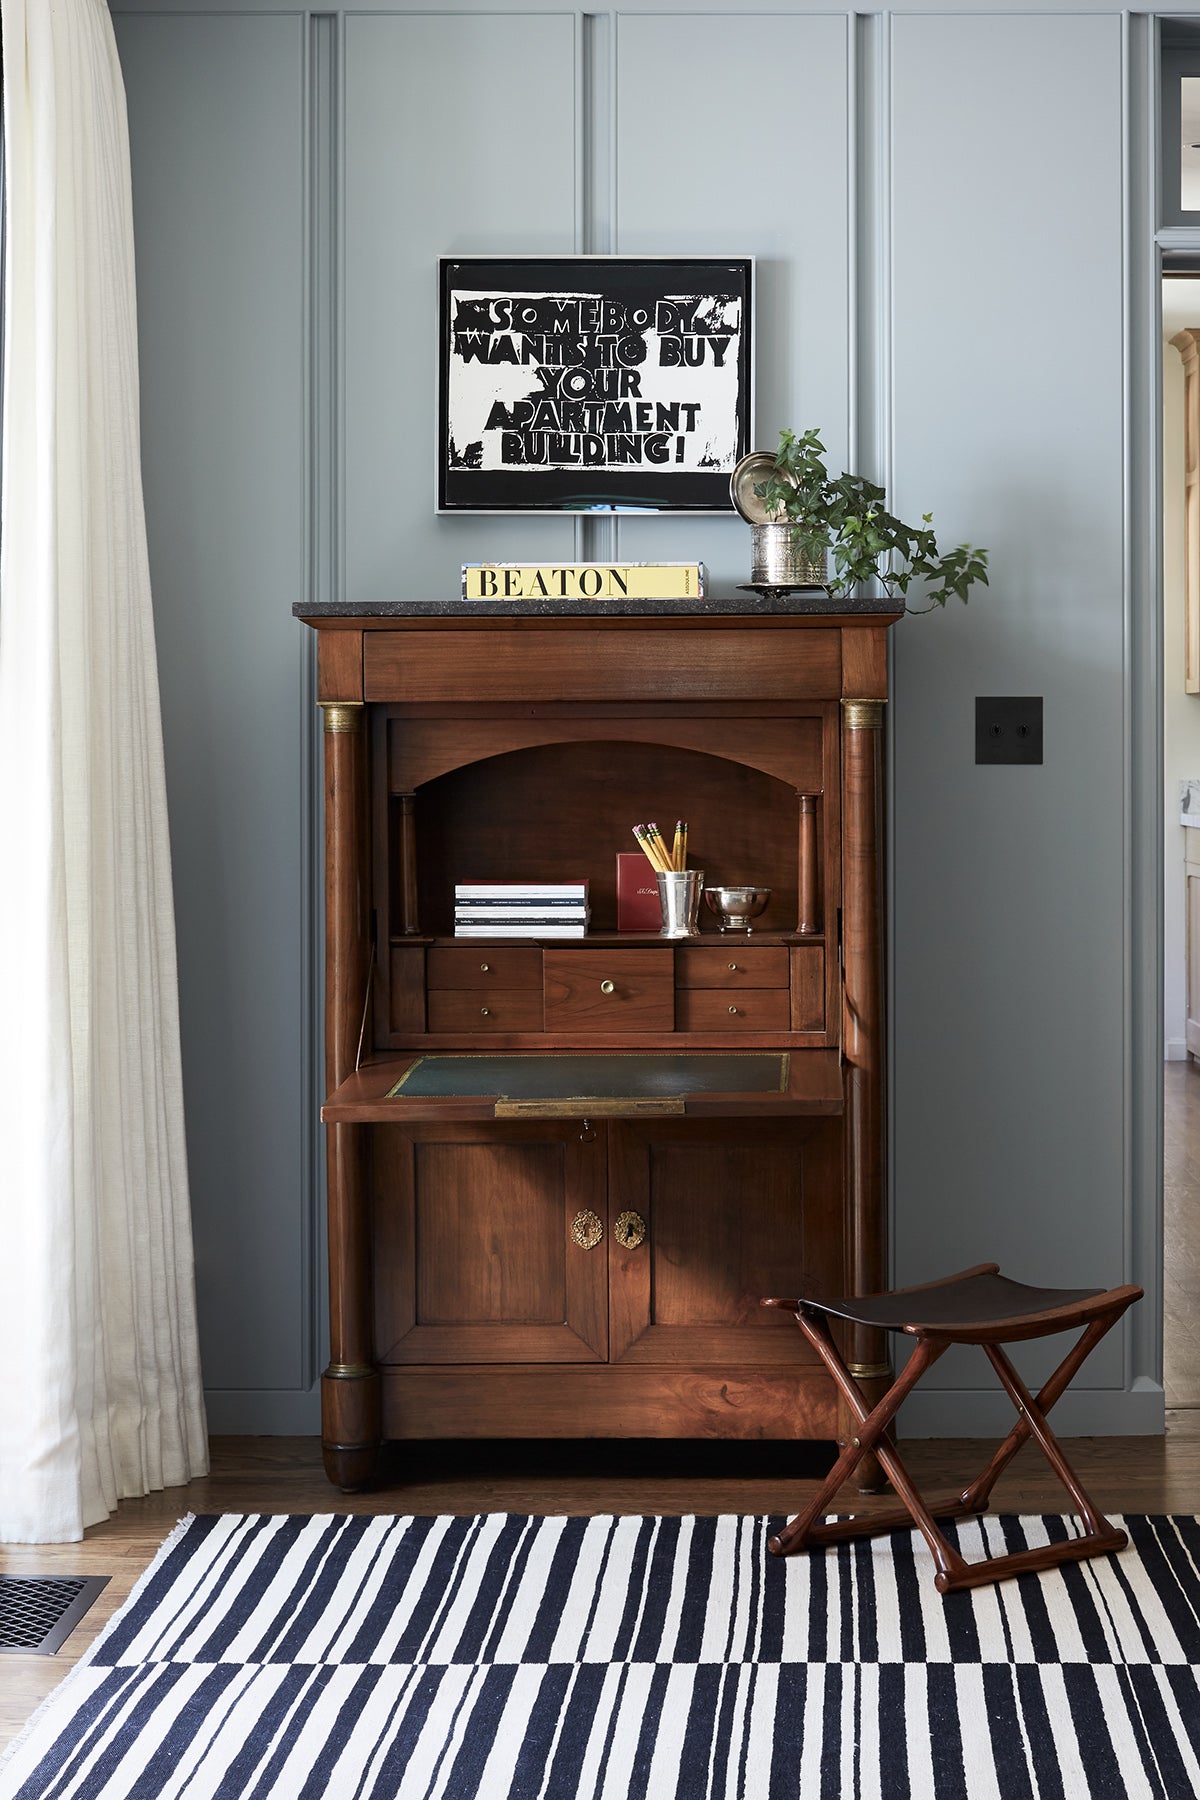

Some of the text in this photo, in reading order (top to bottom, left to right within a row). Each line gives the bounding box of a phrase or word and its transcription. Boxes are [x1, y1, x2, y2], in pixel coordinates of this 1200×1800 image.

[489, 299, 699, 334] SOMEBODY
[458, 334, 731, 367] WANTS TO BUY
[538, 368, 641, 400] YOUR
[484, 401, 701, 432] APARTMENT
[501, 432, 686, 464] BUILDING!
[477, 569, 630, 596] BEATON
